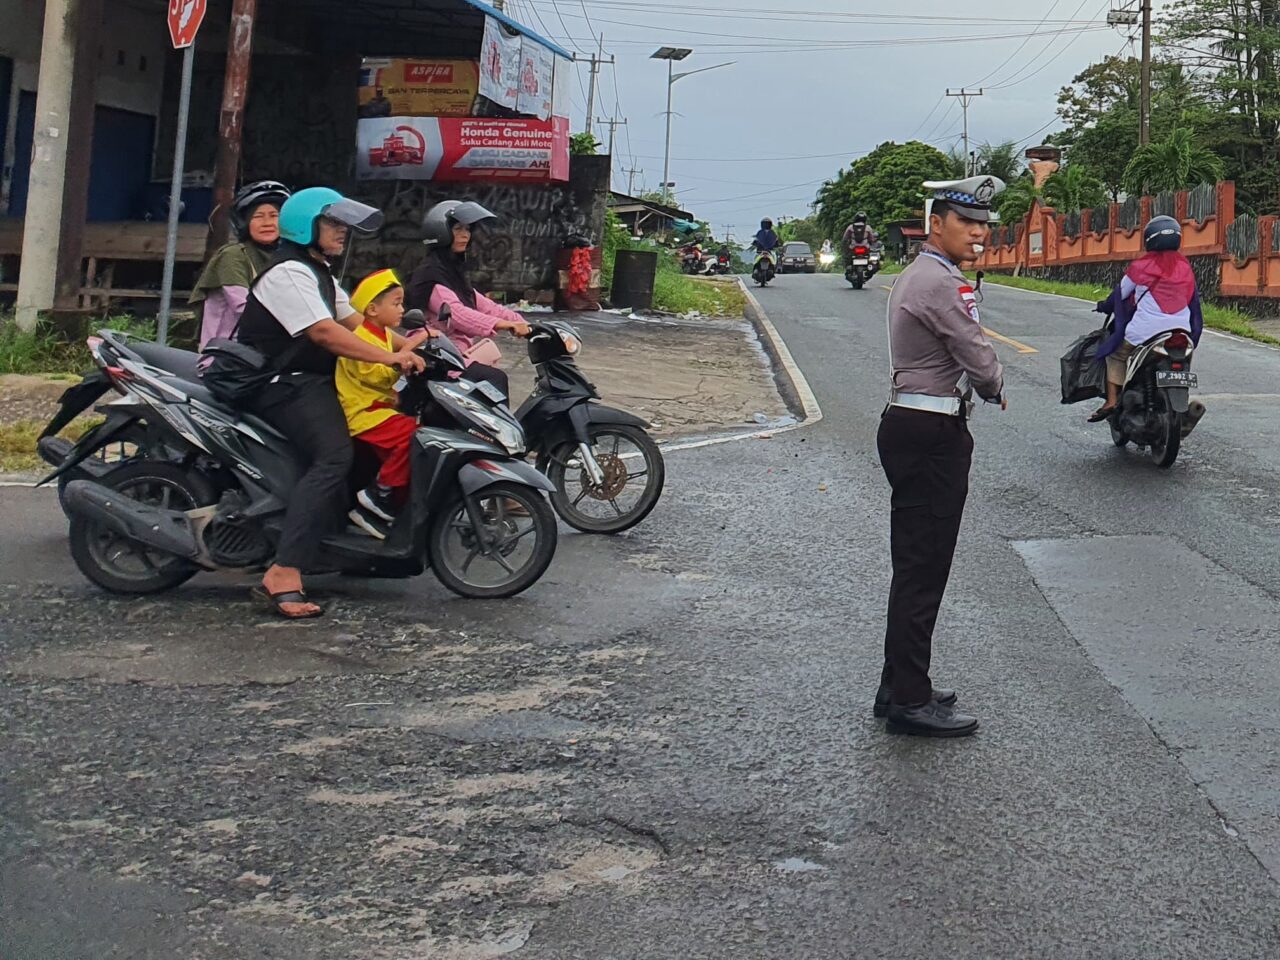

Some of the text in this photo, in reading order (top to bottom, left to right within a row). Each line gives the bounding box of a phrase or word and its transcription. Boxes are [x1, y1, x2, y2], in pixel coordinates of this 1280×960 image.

[411, 65, 450, 77] ASPIRA
[460, 127, 552, 139] Honda Genuine
[460, 138, 481, 146] Suku
[482, 139, 513, 148] Cadang
